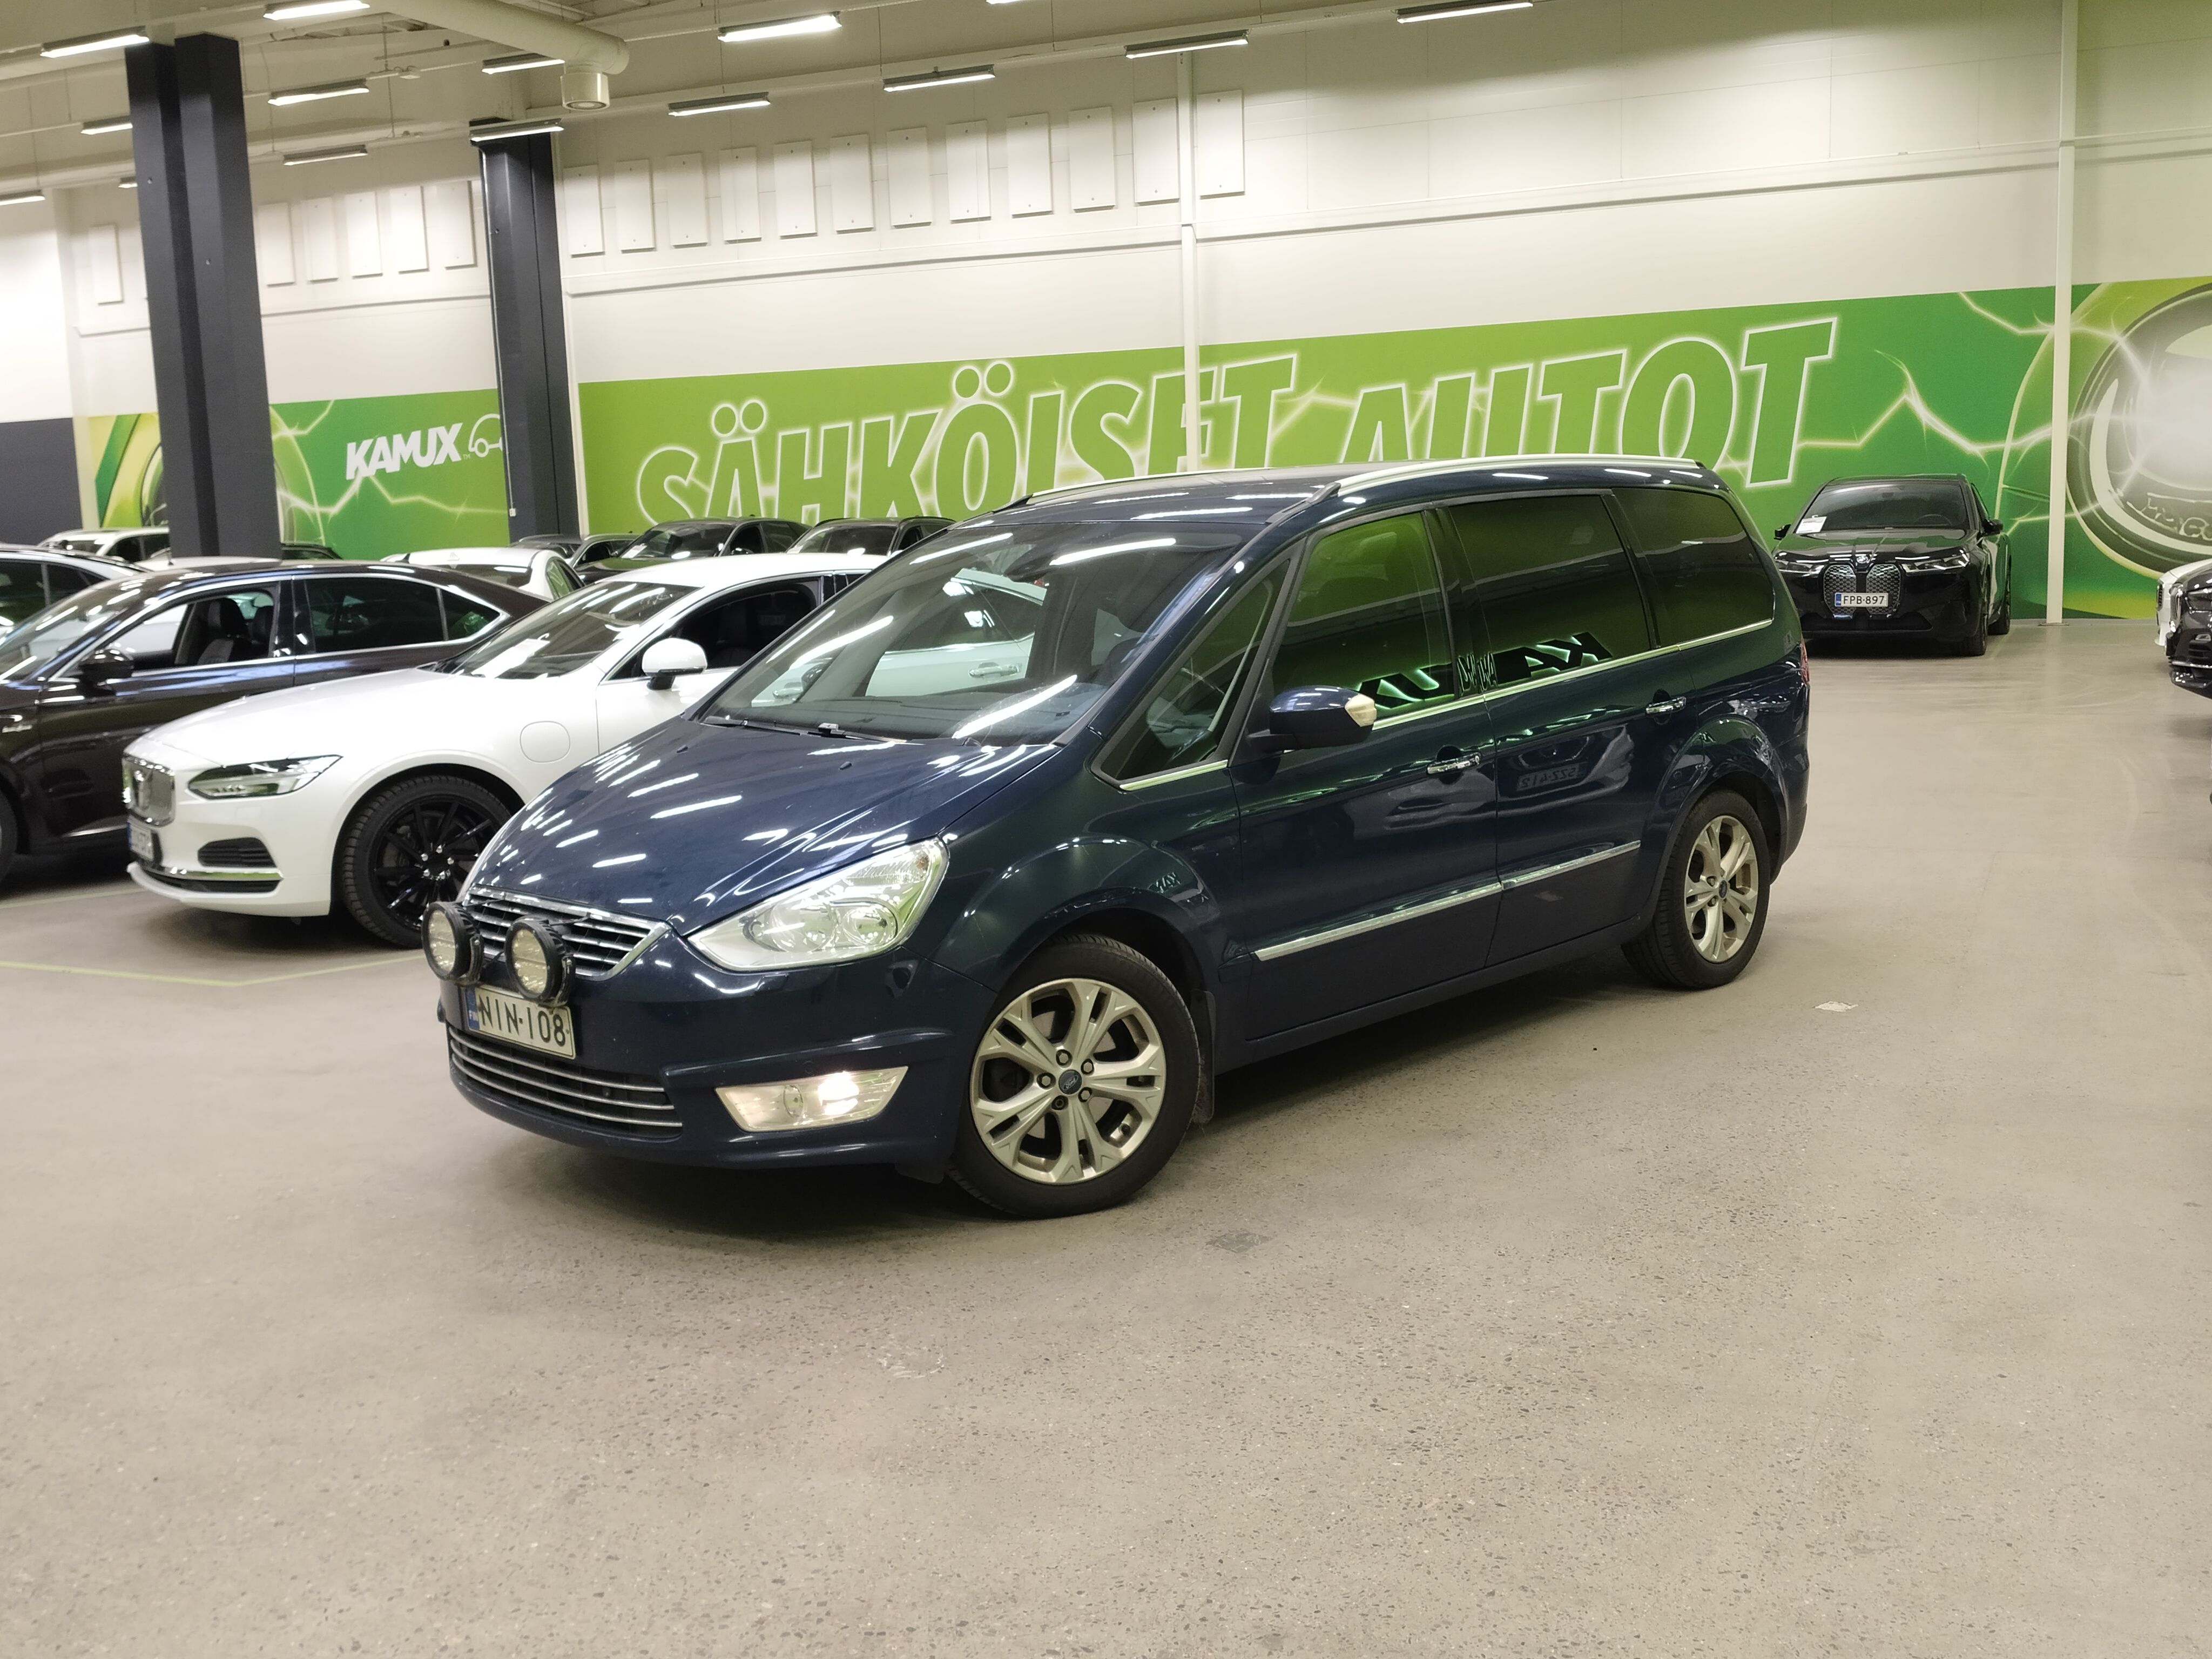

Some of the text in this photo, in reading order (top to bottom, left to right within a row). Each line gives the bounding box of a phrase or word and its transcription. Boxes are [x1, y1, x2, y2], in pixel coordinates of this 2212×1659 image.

[346, 422, 463, 480] KAMUX
[1843, 595, 1885, 605] FPB-897
[478, 996, 566, 1047] NIN-108
